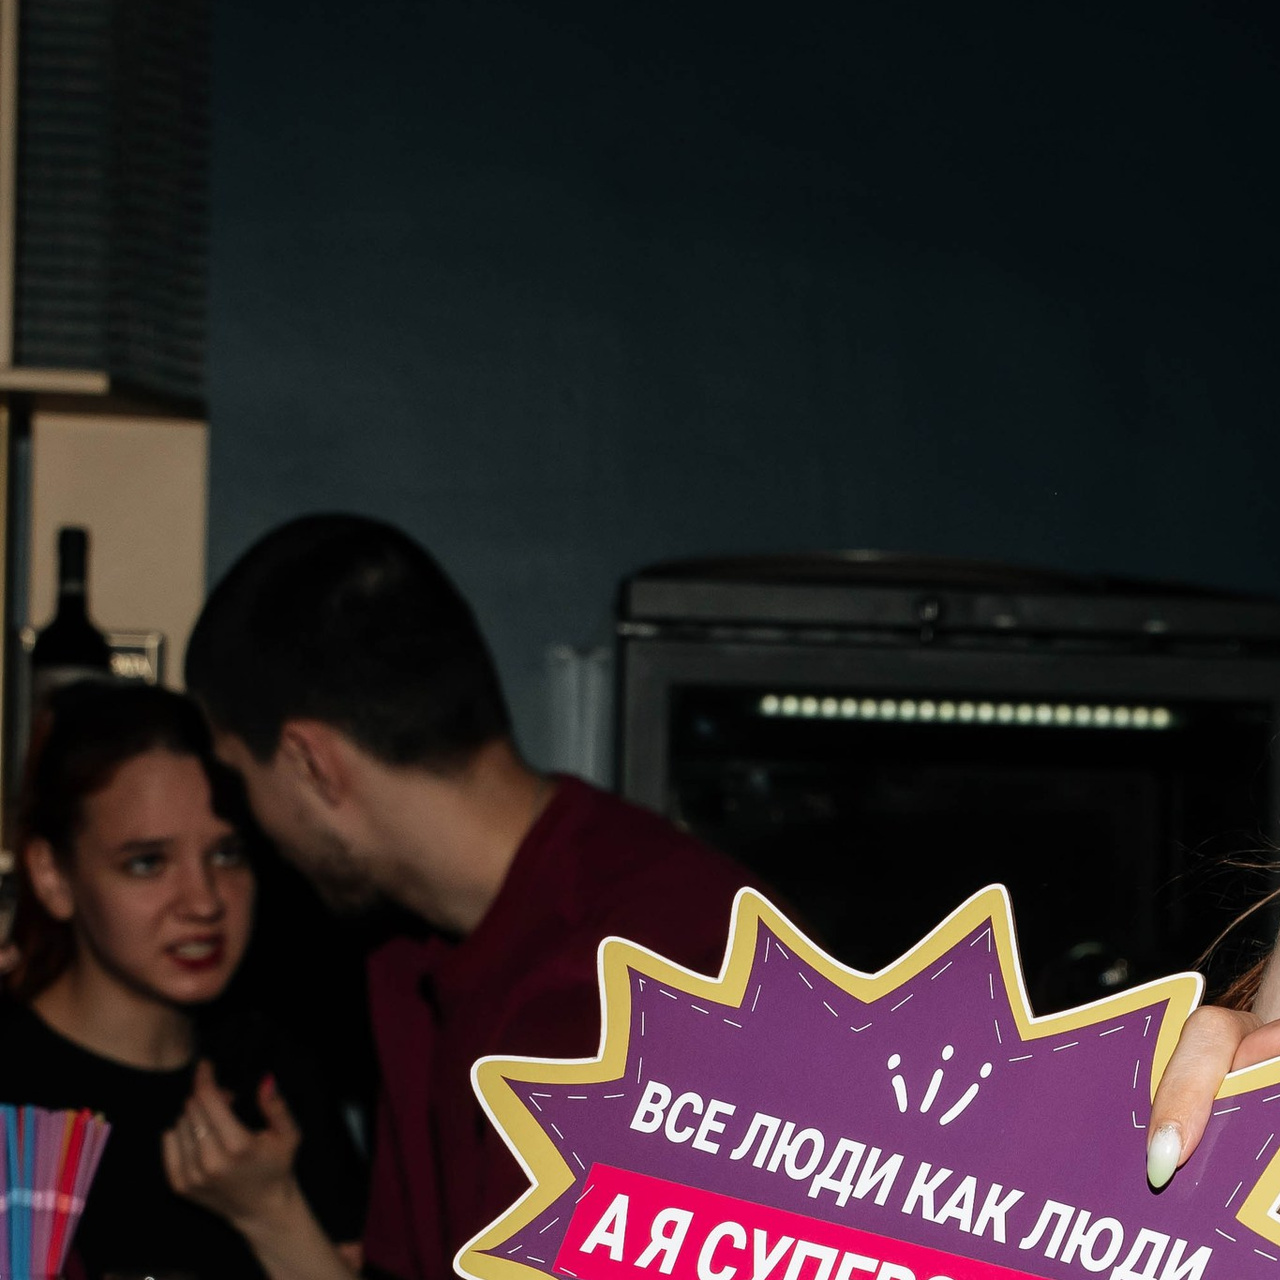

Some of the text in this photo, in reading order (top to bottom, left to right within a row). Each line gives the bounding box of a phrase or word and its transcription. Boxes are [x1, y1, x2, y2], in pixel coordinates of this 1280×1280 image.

[630, 1080, 736, 1155] ВСЕ
[730, 1113, 905, 1208] ЛЮДИ
[901, 1162, 1026, 1244] КАК
[579, 1193, 630, 1262] А
[634, 1208, 694, 1275] Я
